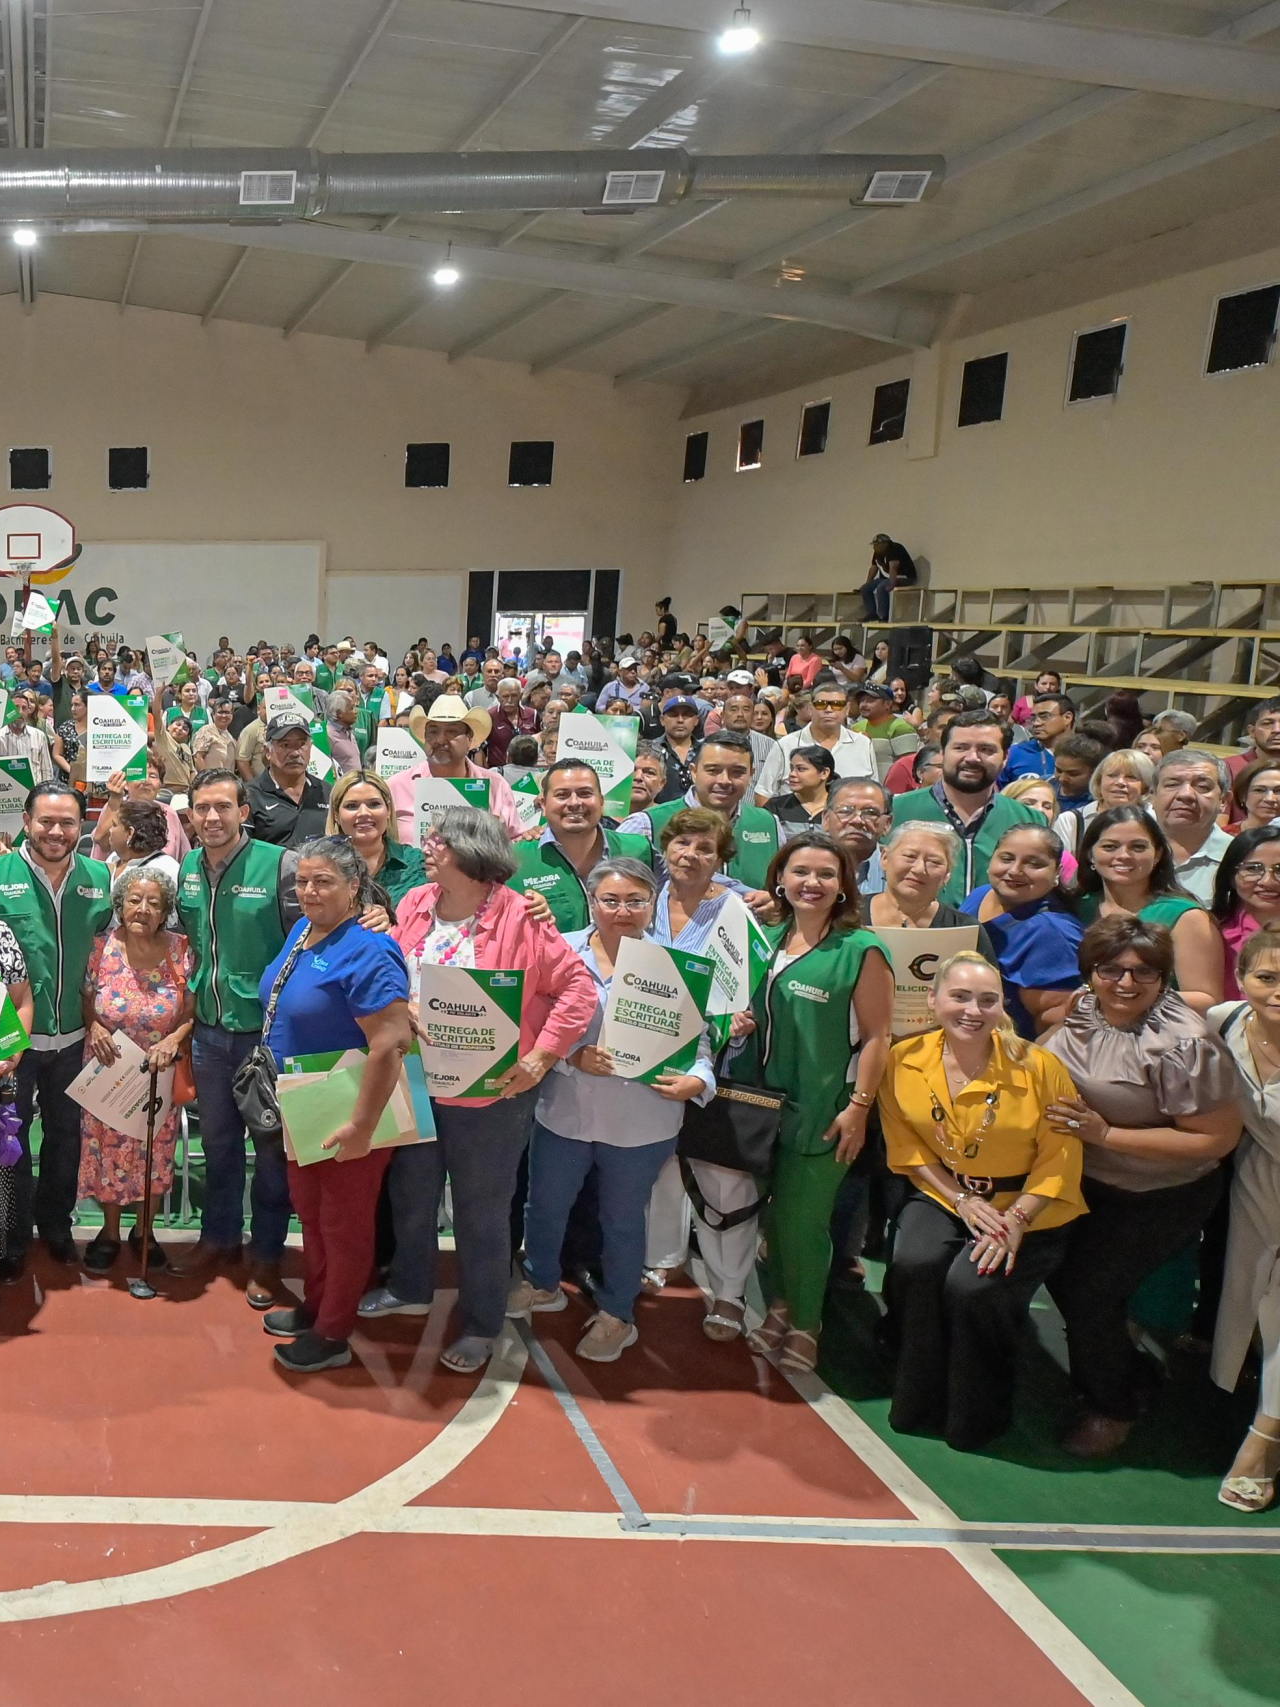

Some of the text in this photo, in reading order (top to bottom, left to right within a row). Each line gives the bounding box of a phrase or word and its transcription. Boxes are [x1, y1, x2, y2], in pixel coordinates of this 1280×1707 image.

[63, 633, 75, 645] de
[92, 717, 126, 725] COAHUILA
[564, 738, 609, 748] COAHUILA
[381, 748, 417, 756] COAHUILA
[603, 759, 614, 767] DE
[523, 873, 561, 887] MEJORA
[231, 884, 267, 894] COAHUILA
[717, 926, 744, 966] COAHUILA
[708, 943, 740, 989] ENTREGA DE
[907, 953, 939, 981] C
[622, 972, 679, 995] COAHUILA
[894, 984, 929, 992] ELICID
[428, 998, 487, 1013] COAHUILA
[617, 997, 683, 1021] ENTREGA DE
[614, 1007, 681, 1030] ESCRITURAS
[427, 1023, 496, 1036] ENTREGA DE
[427, 1031, 496, 1045] ESCRITURAS
